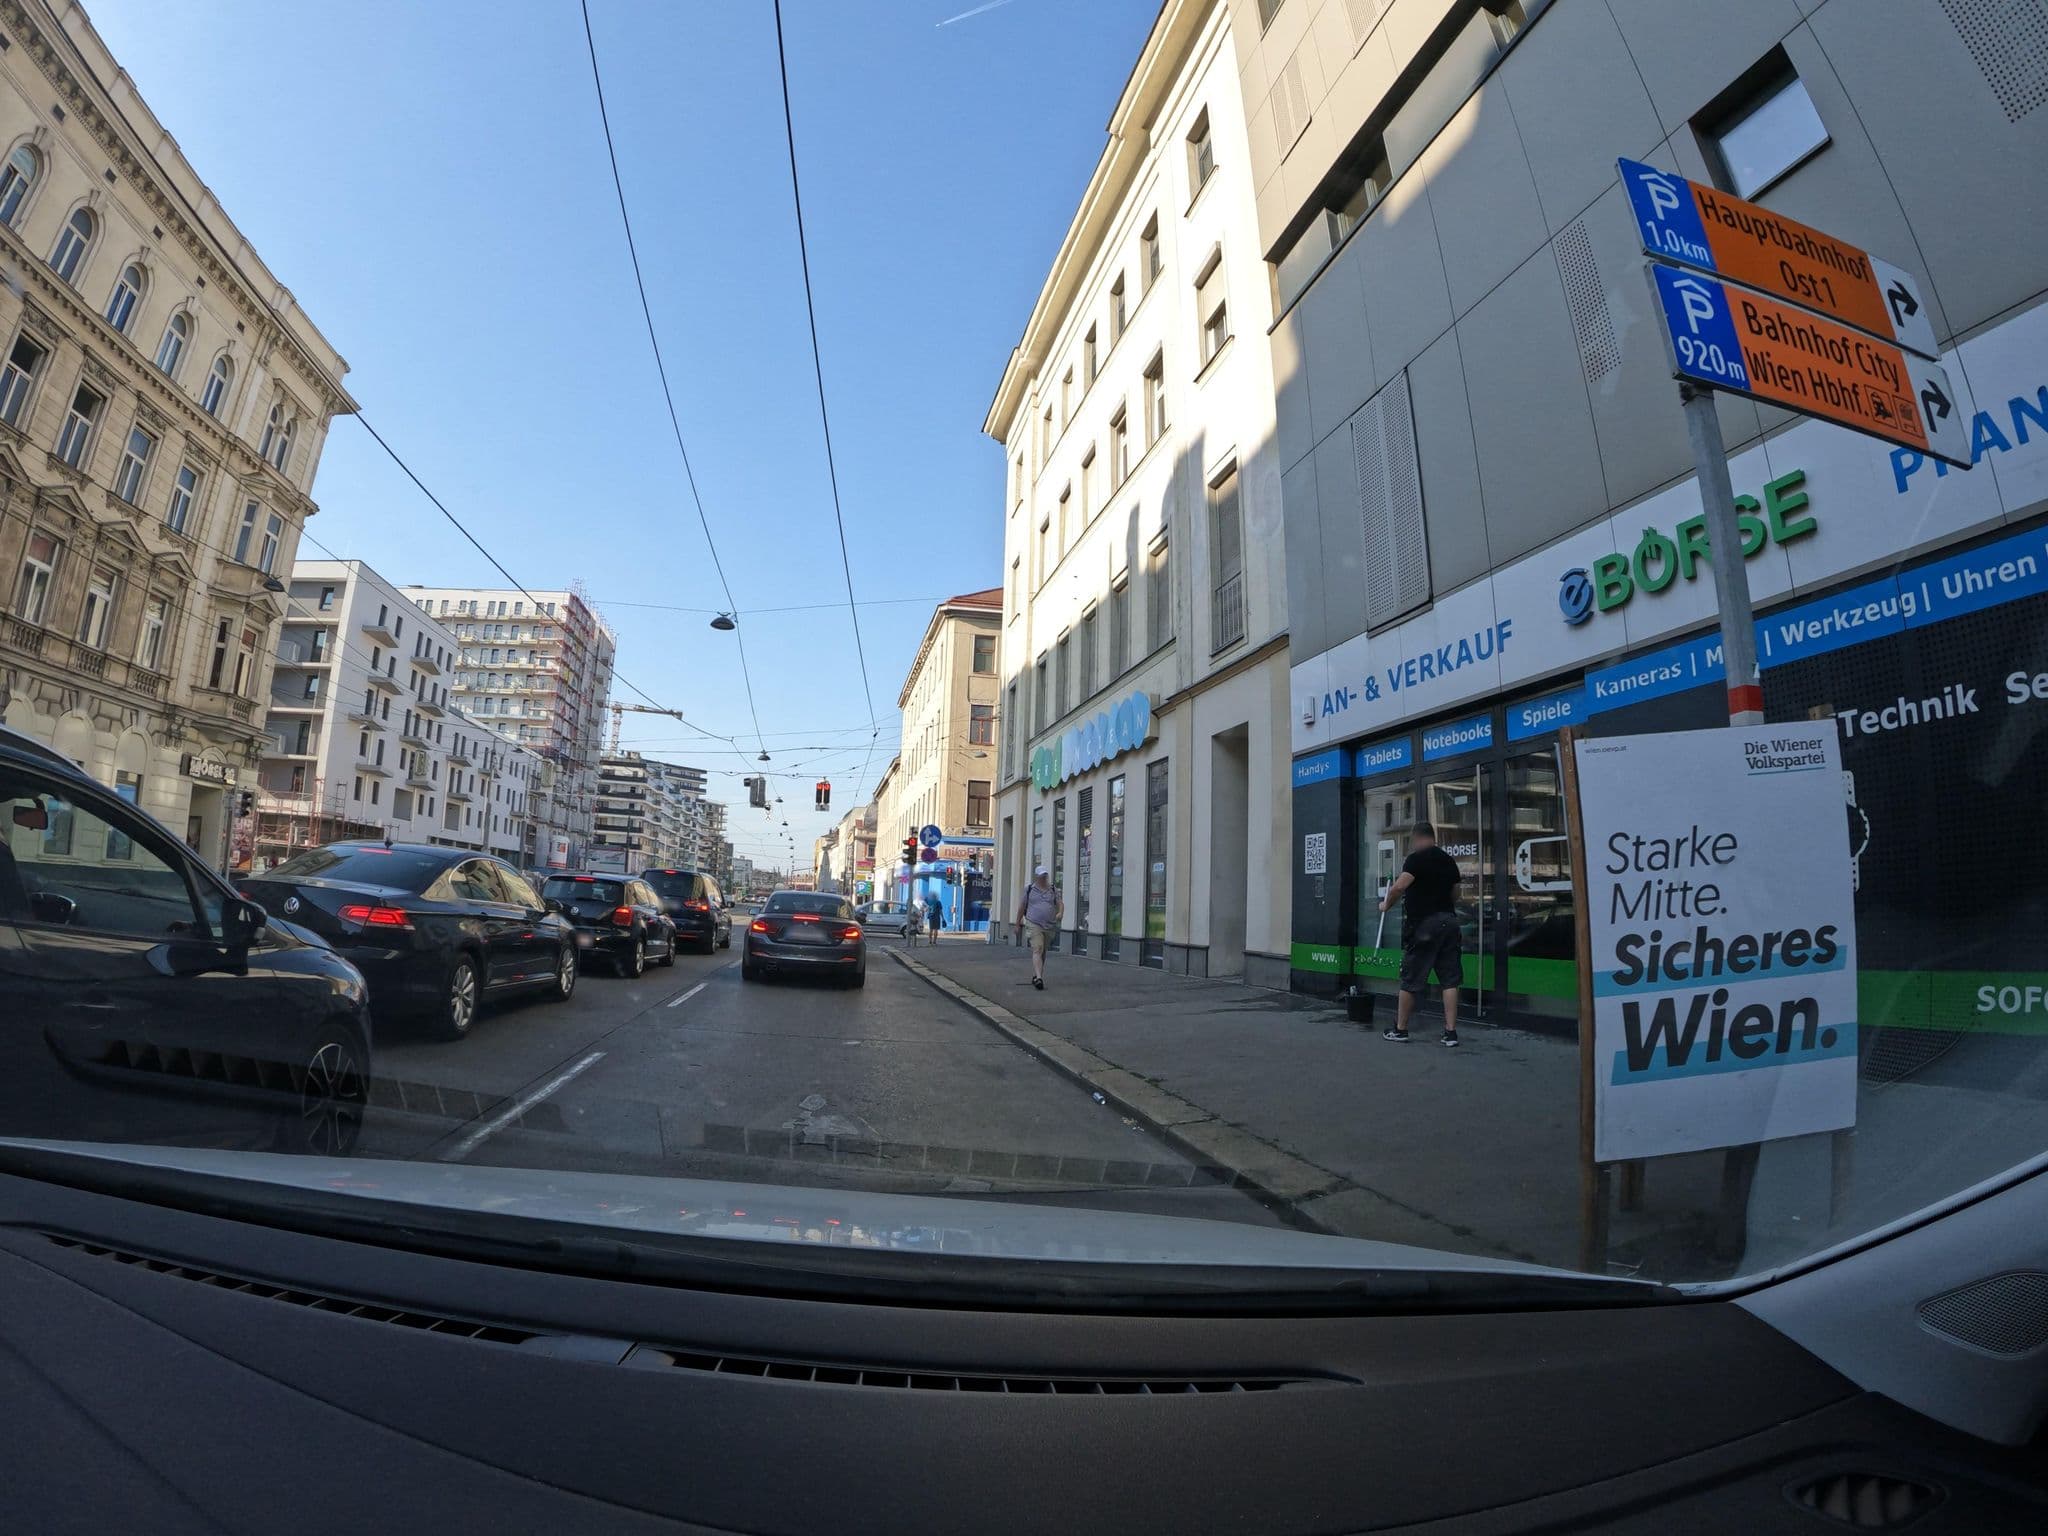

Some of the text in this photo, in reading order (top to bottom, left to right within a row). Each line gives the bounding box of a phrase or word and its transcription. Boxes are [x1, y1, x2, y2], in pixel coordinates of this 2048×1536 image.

[1697, 190, 1871, 283] Hauptbahnhof
[1741, 300, 1901, 393] Bahnhof City
[1744, 345, 1870, 418] Wien Hbhf.
[1942, 555, 2038, 600] Uhren
[1780, 588, 1917, 648] Werkzeug
[1321, 619, 1514, 718] AN- & VERKAUF
[1595, 659, 1683, 698] Kameras
[1521, 699, 1573, 727] Spiele
[1837, 683, 1980, 738] Technik
[1363, 747, 1403, 767] Tablets
[1422, 722, 1493, 752] Notebooks
[1744, 738, 1823, 756] Die Wiener
[1297, 760, 1331, 777] Handys
[1746, 751, 1826, 770] Volkspartei
[1605, 825, 1738, 875] Starke
[1610, 879, 1728, 925] Mitte.
[1611, 924, 1839, 987] Sicheres
[1976, 985, 2048, 1014] SOF
[1621, 988, 1838, 1073] Wien.
